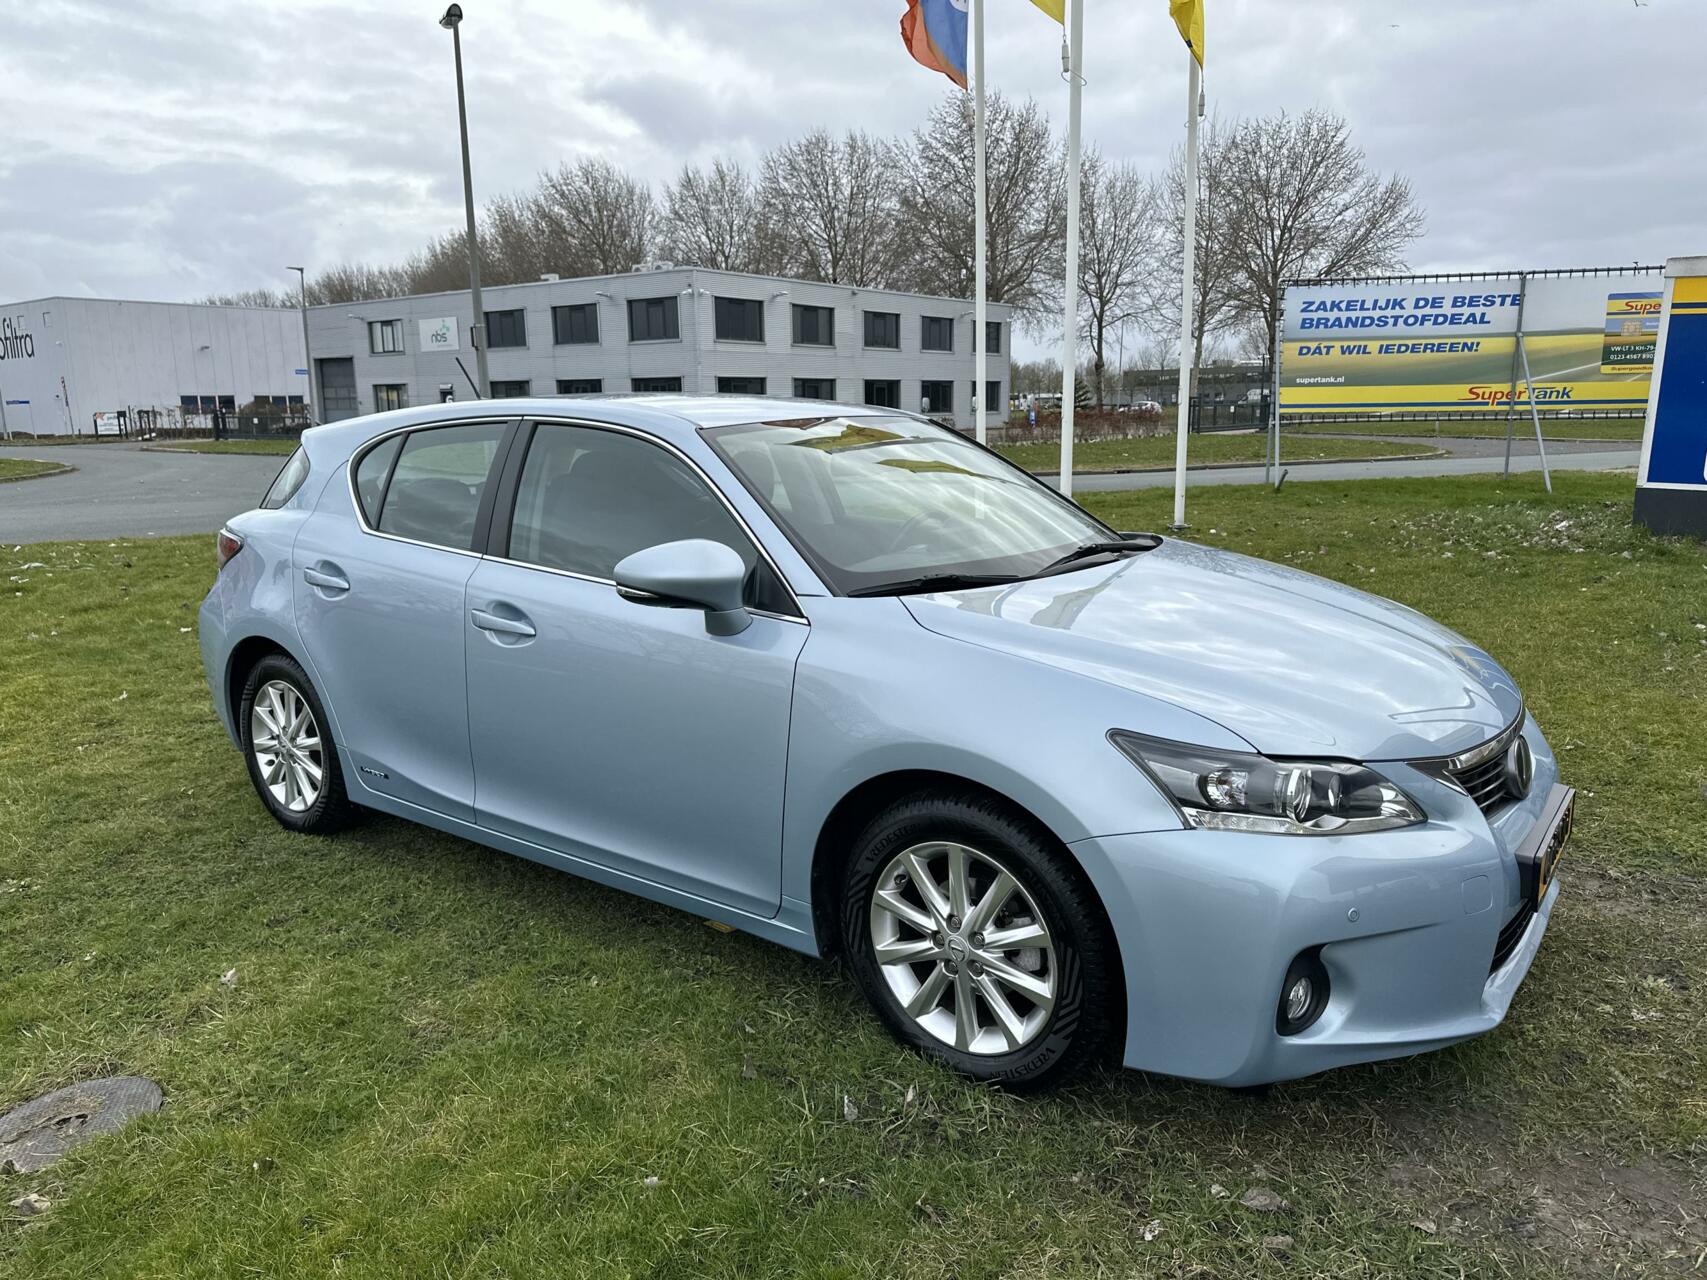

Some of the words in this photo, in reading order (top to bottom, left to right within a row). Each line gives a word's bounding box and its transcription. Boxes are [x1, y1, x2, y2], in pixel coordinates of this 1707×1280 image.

[1300, 298, 1407, 313] ZAKELIJK
[1413, 296, 1445, 310] DE
[1451, 294, 1525, 308] BESTE
[1300, 312, 1491, 329] BRANDSTOFDEAL
[431, 331, 448, 343] nbs
[1298, 343, 1335, 356] DÁT
[1340, 344, 1371, 356] WIL
[1378, 342, 1481, 355] IEDEREEN!
[1296, 375, 1345, 385] supertank.nl
[1457, 386, 1570, 406] SuperTank
